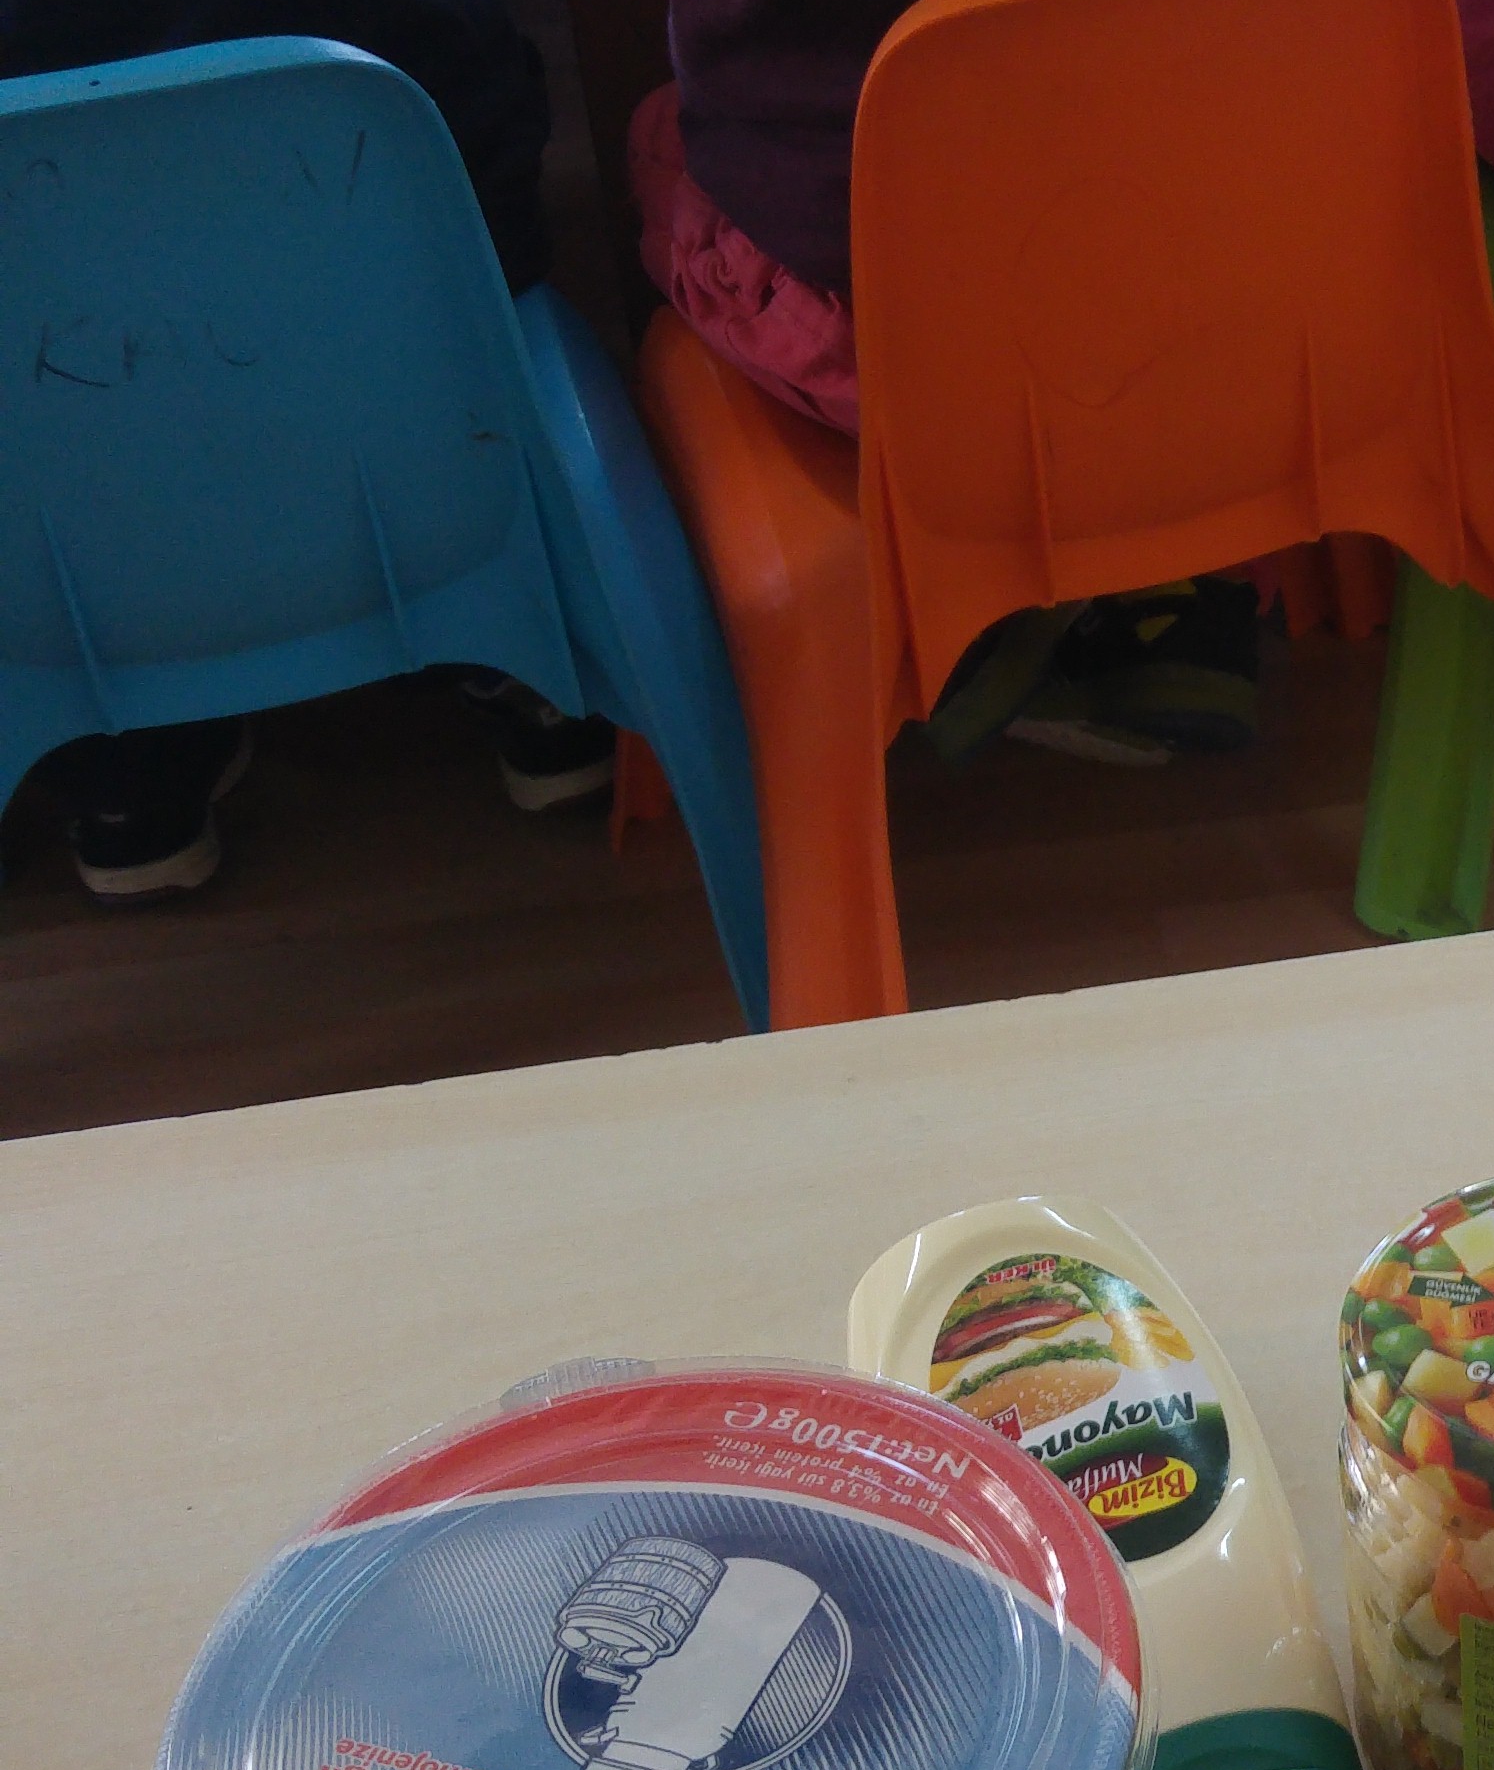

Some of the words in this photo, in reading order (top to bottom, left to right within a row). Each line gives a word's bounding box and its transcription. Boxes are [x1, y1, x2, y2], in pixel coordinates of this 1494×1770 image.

[1028, 1391, 1197, 1460] Mayon
[773, 1448, 843, 1469] protein
[1068, 1453, 1143, 1500] Mutfa
[1101, 1469, 1187, 1513] Bizim
